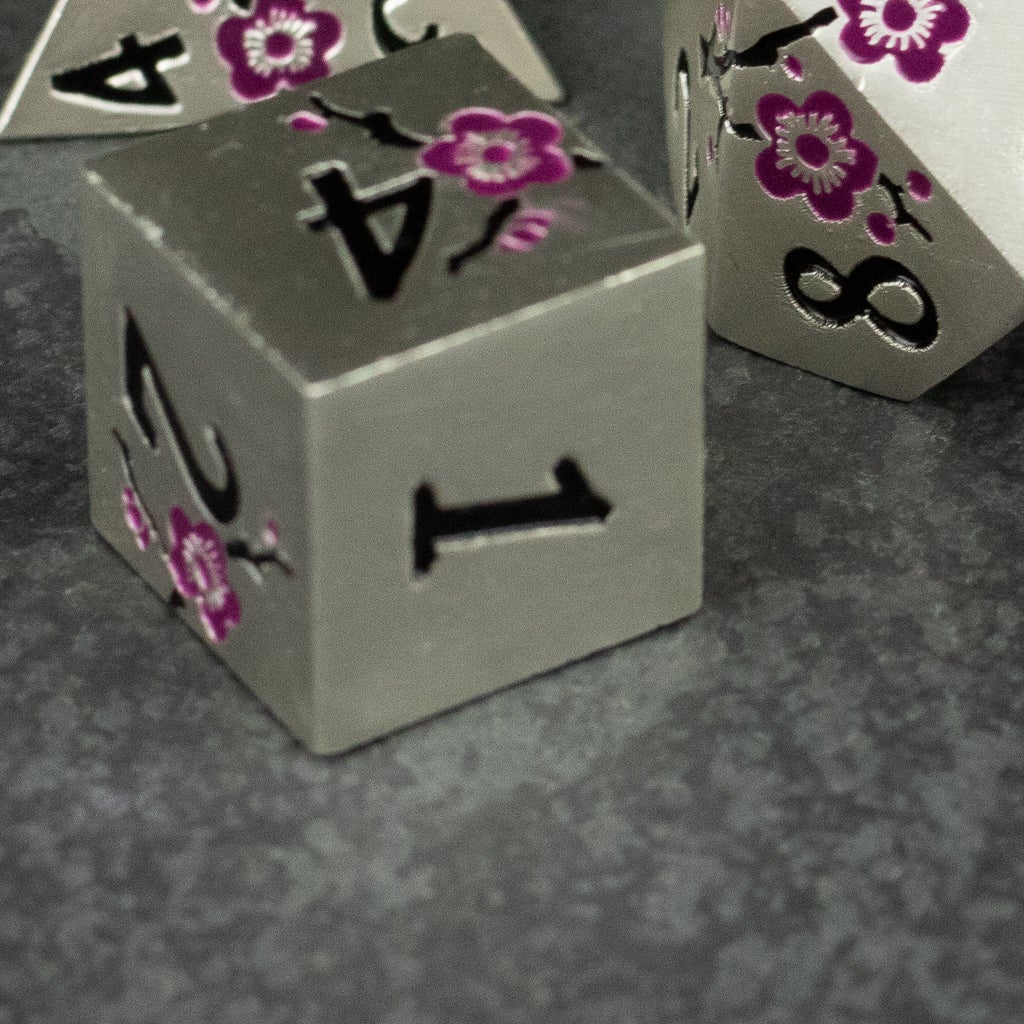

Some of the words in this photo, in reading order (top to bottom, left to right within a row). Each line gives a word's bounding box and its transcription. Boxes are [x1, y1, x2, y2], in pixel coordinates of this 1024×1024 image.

[51, 31, 190, 111] 4
[300, 161, 435, 301] 4
[783, 246, 940, 351] 8
[122, 307, 238, 524] 2
[413, 455, 614, 577] 1
